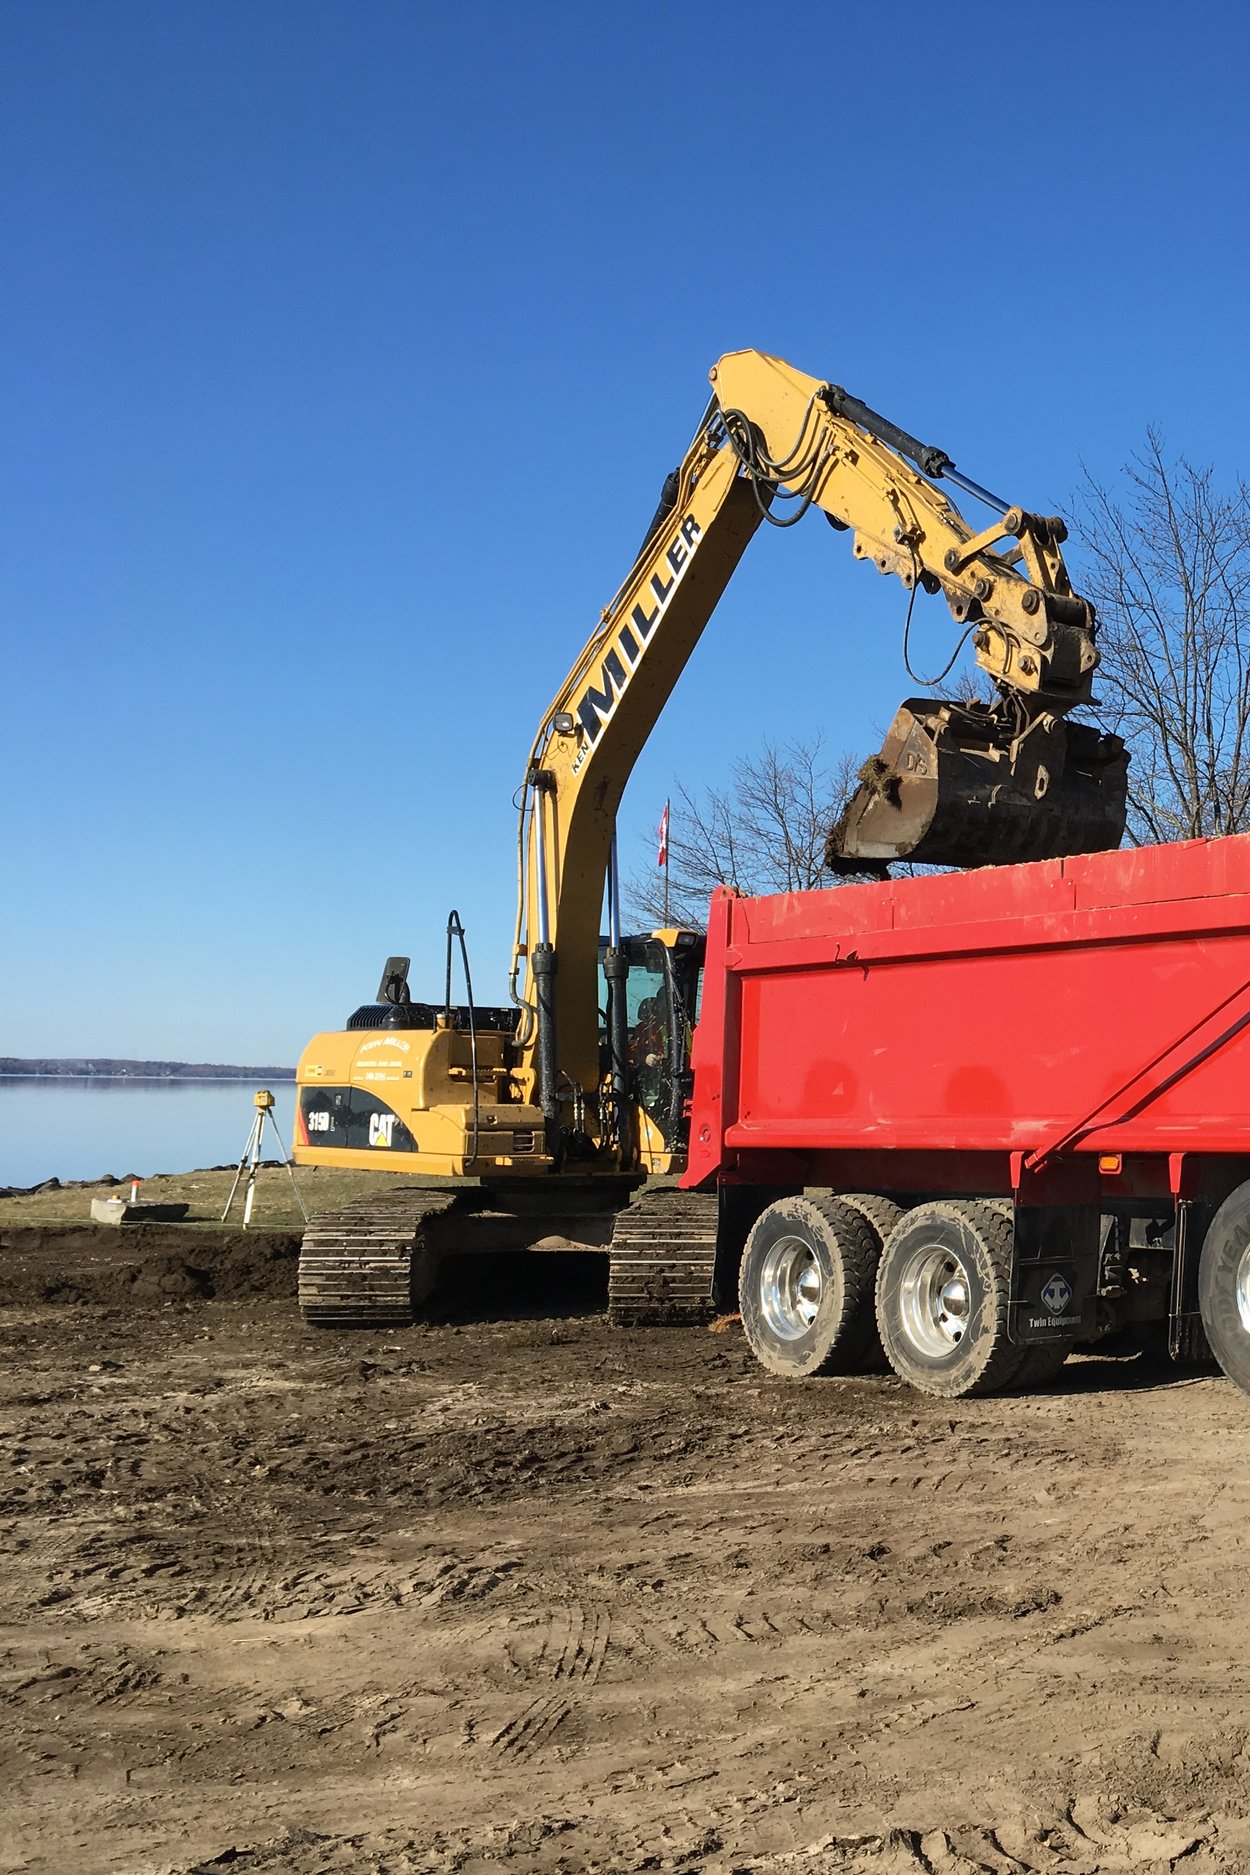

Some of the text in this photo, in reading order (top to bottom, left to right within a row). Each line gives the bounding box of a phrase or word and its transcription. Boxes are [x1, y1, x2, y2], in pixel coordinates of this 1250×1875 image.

[571, 513, 702, 774] KEN MILLER
[368, 1112, 396, 1148] CAT
[1029, 1318, 1047, 1328] Twin
